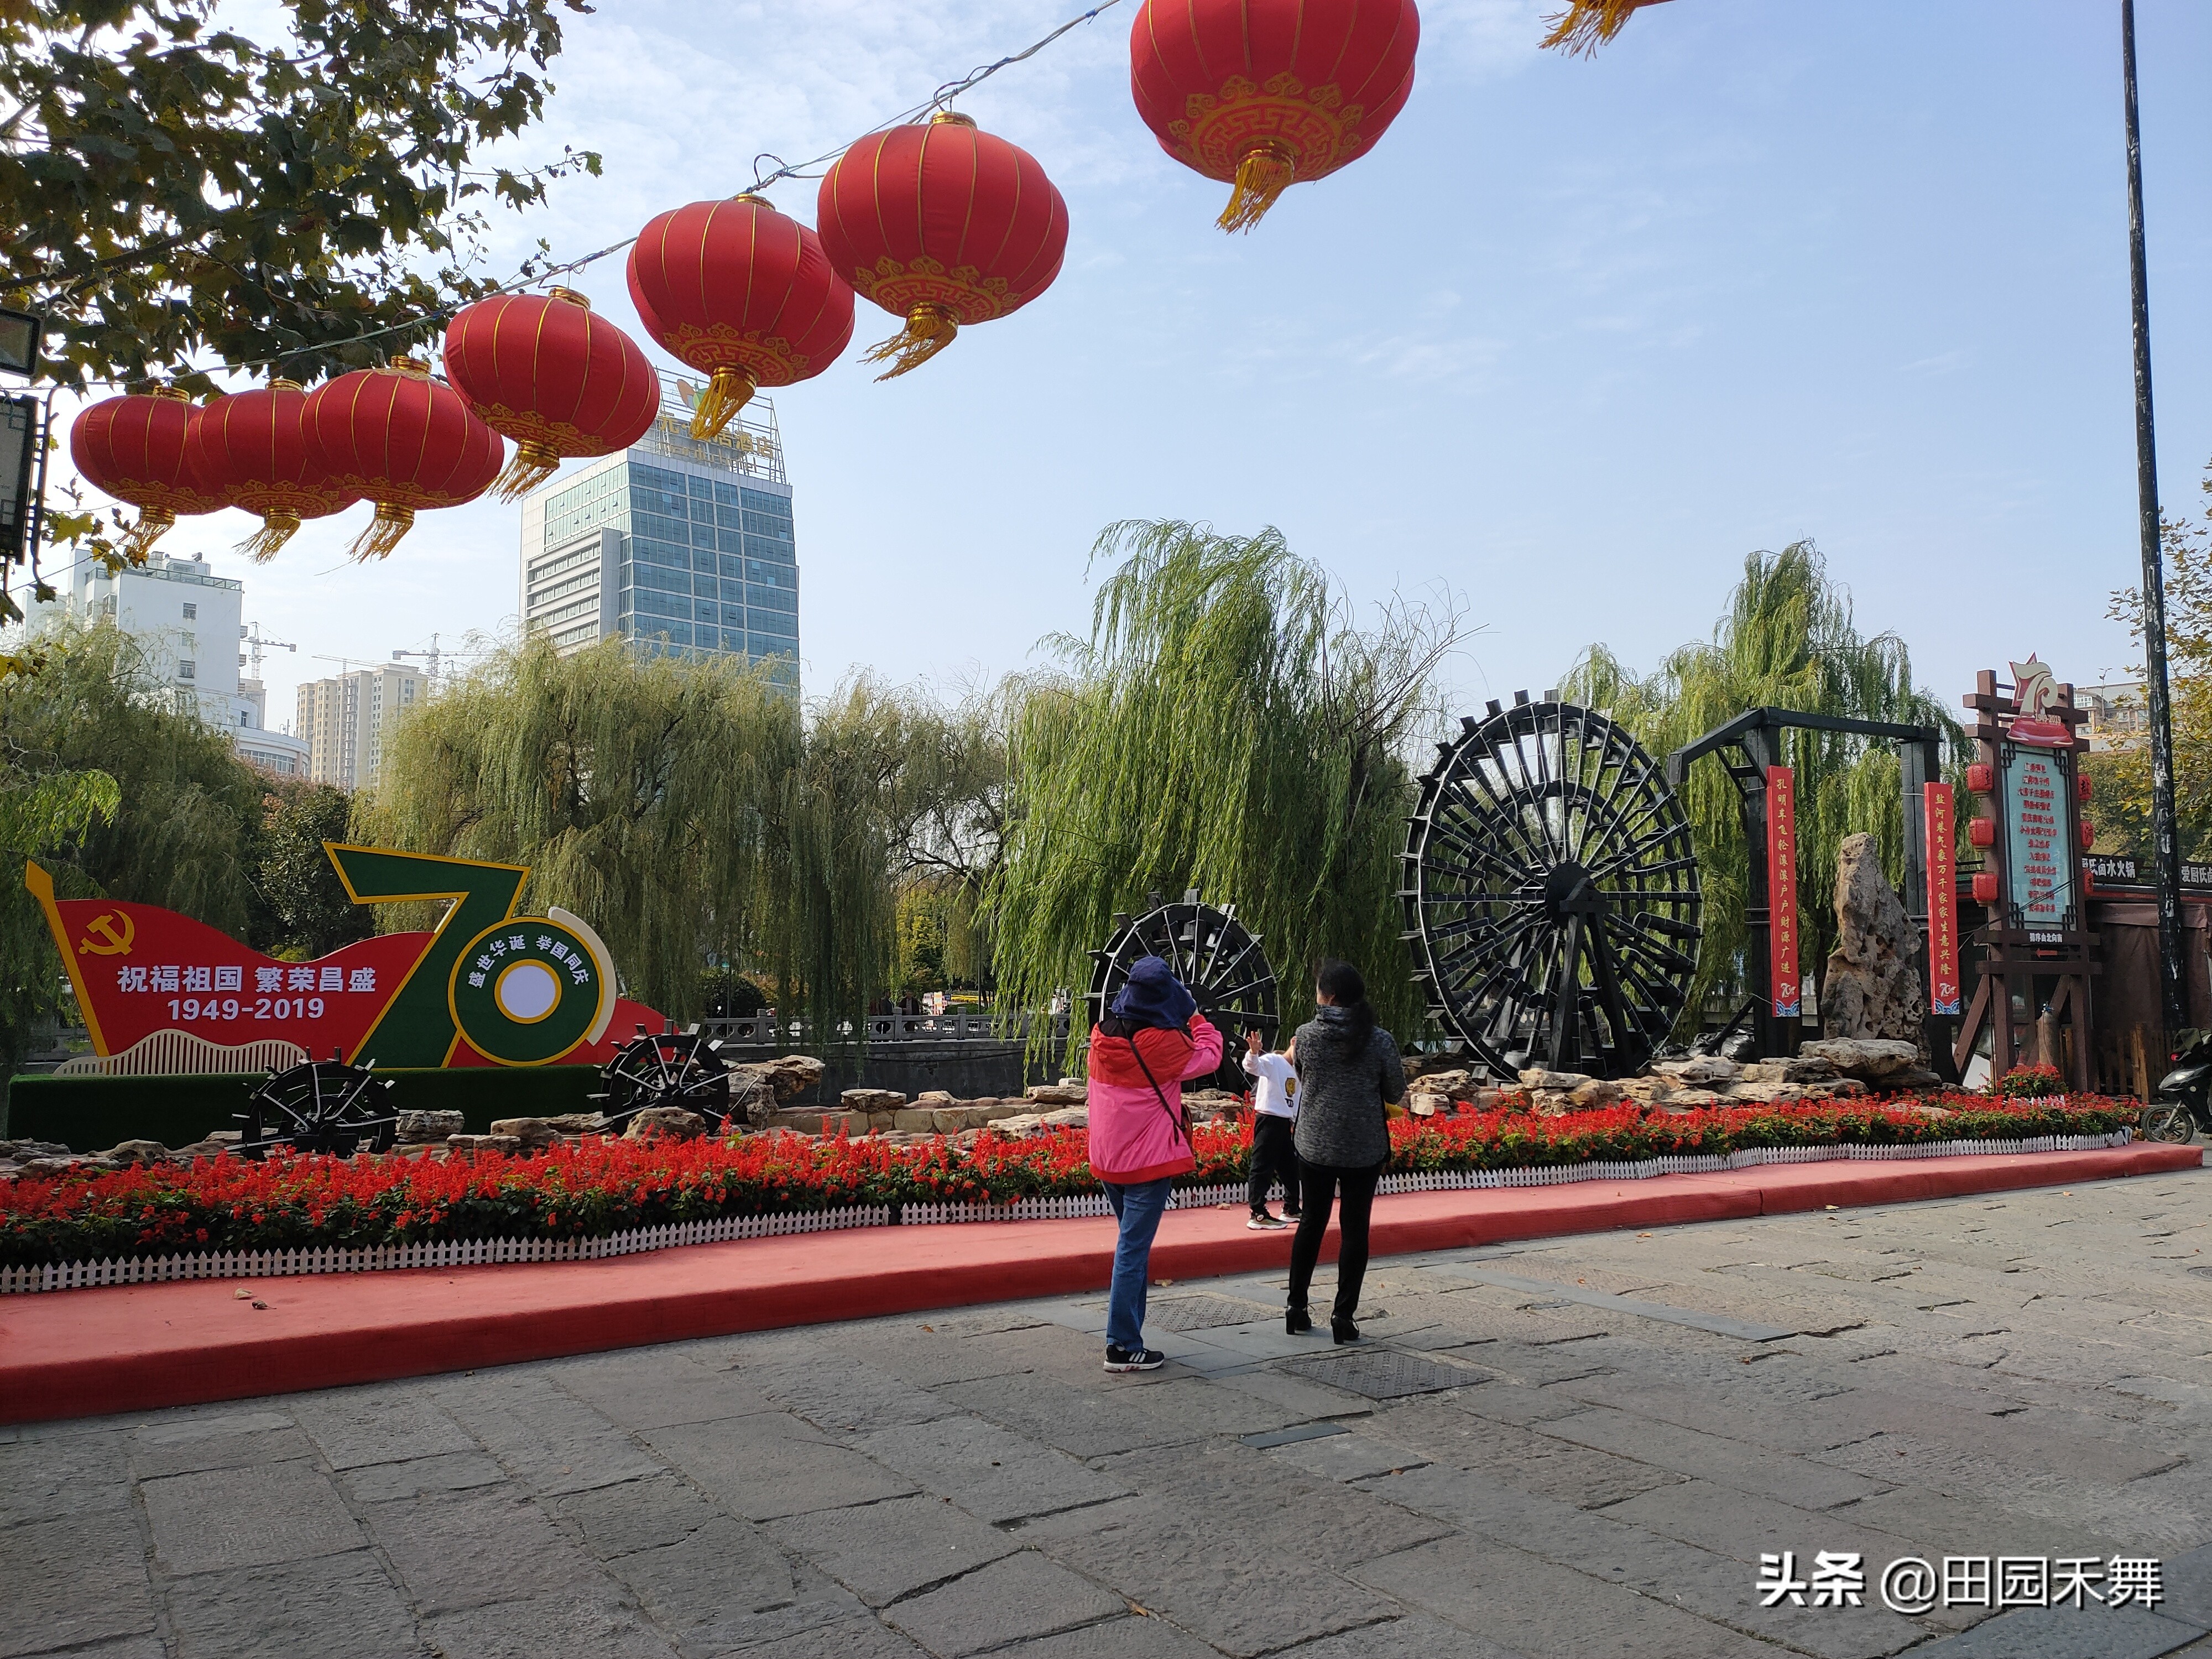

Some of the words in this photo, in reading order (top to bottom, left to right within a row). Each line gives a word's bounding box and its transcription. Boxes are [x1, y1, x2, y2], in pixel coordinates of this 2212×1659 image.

[657, 410, 774, 459] 元·居酒店
[2034, 713, 2062, 725] 1949-2019
[1776, 778, 1791, 973] 孔明车飞轮滚滚户户财源广进
[1934, 794, 1952, 975] 盐河巷气象万千家家生意兴隆
[117, 966, 243, 993] 祝福祖国
[254, 966, 377, 993] 繁荣昌盛
[468, 934, 526, 989] 盛世华诞
[535, 934, 589, 985] 举国同庆
[167, 998, 325, 1020] 1949-2019
